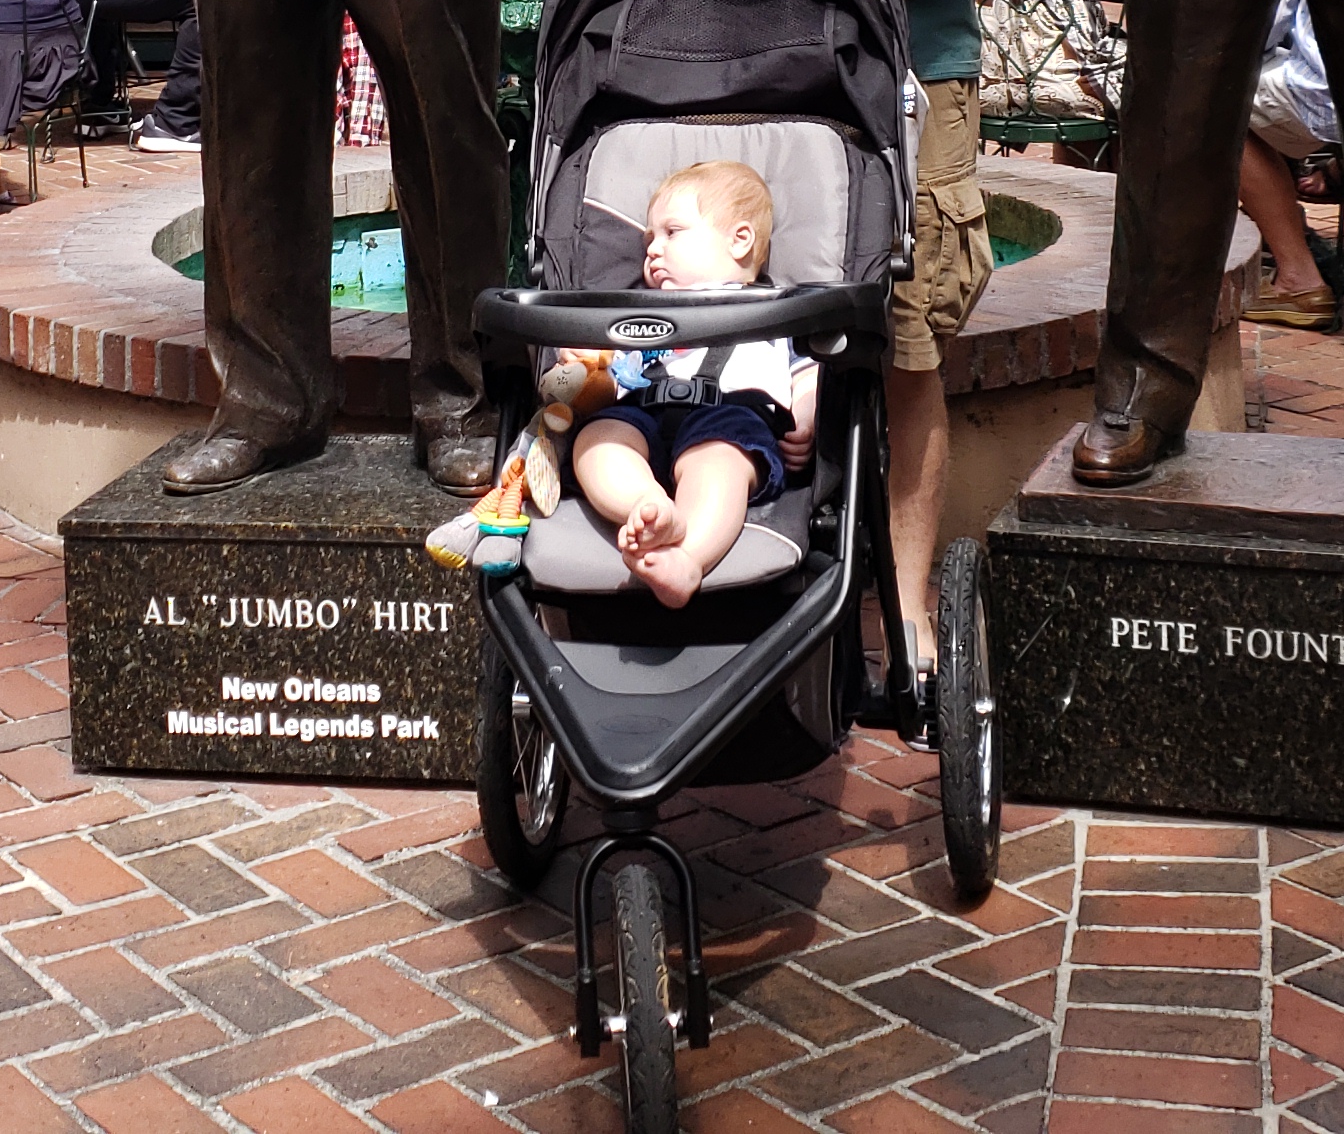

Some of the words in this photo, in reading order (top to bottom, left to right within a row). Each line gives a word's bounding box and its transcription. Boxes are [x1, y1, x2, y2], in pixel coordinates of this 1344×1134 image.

[618, 323, 668, 336] GRACO
[143, 596, 186, 626] AL
[202, 595, 357, 630] "JUMBO"
[373, 600, 454, 633] HIRT
[1110, 617, 1199, 654] PETE
[221, 676, 278, 701] New
[283, 677, 382, 703] Orleans
[167, 711, 263, 736] Musical
[269, 712, 375, 743] Legends
[381, 714, 440, 740] Park
